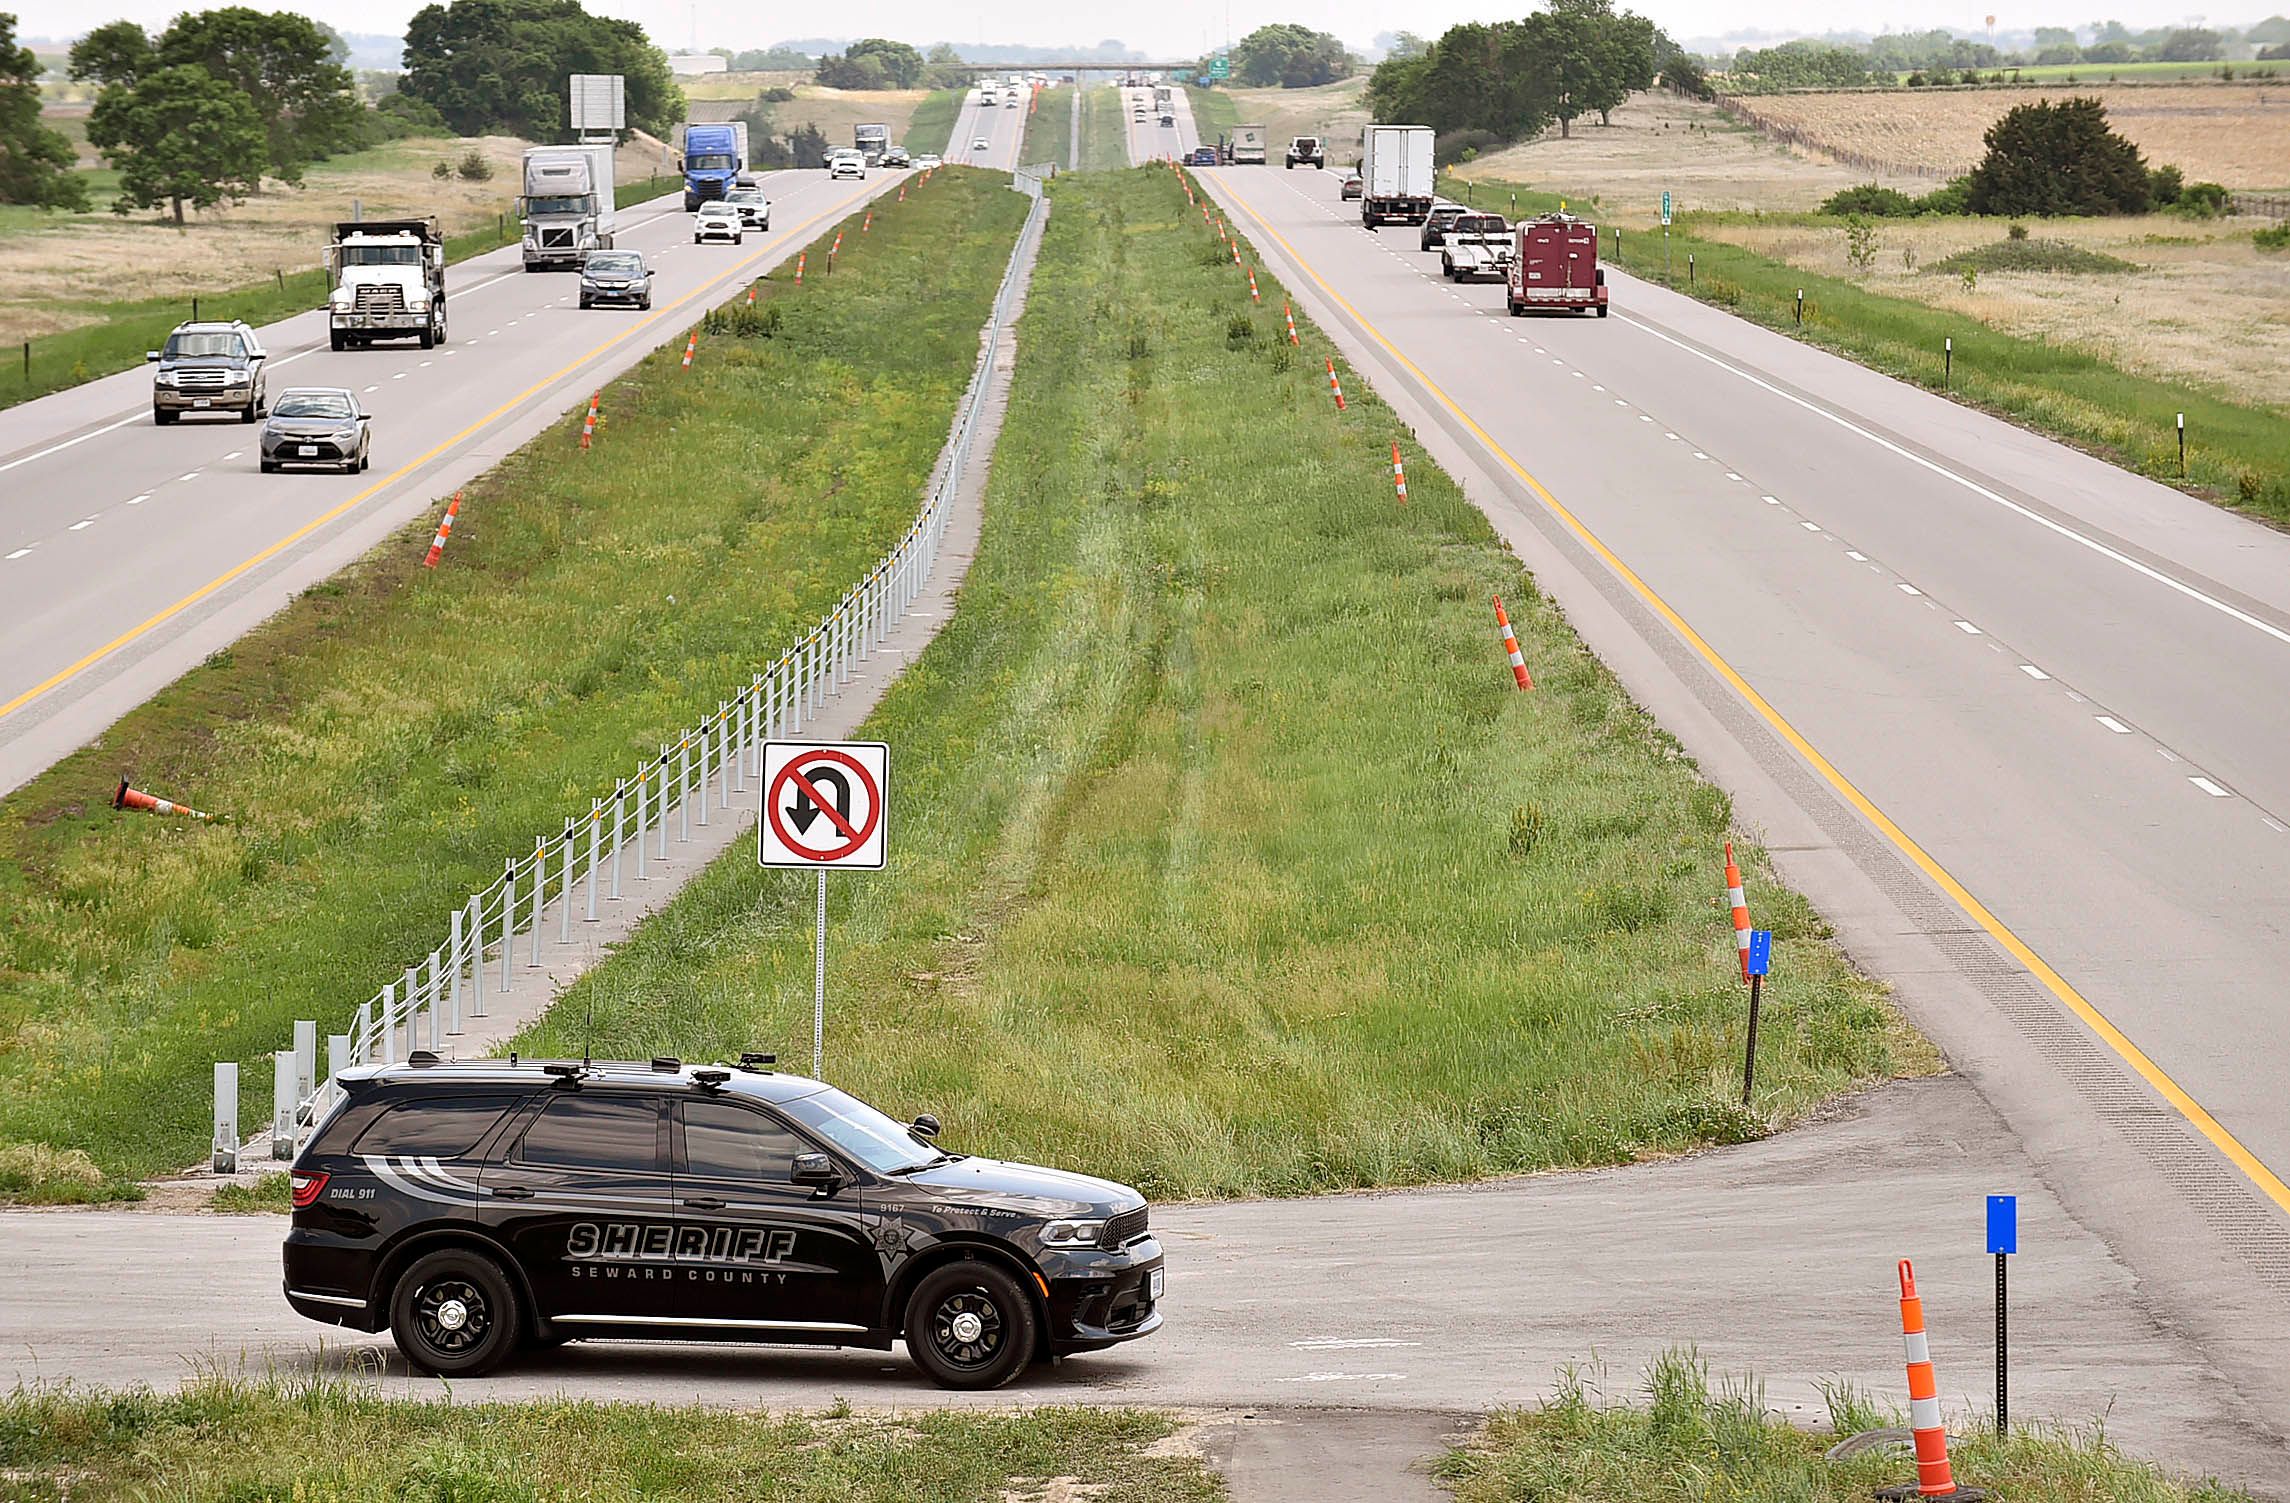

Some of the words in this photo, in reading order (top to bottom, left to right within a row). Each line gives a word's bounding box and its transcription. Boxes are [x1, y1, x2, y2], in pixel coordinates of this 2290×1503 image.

[330, 1189, 355, 1199] DIAL
[359, 1189, 377, 1199] 911
[880, 1204, 904, 1212] 9167
[932, 1205, 942, 1213] To
[943, 1206, 980, 1215] Protect
[980, 1208, 988, 1216] &
[989, 1209, 1016, 1218] Serve
[567, 1223, 797, 1263] SHERIFF
[572, 1267, 673, 1279] SEWARD
[689, 1270, 787, 1284] COUNTY
